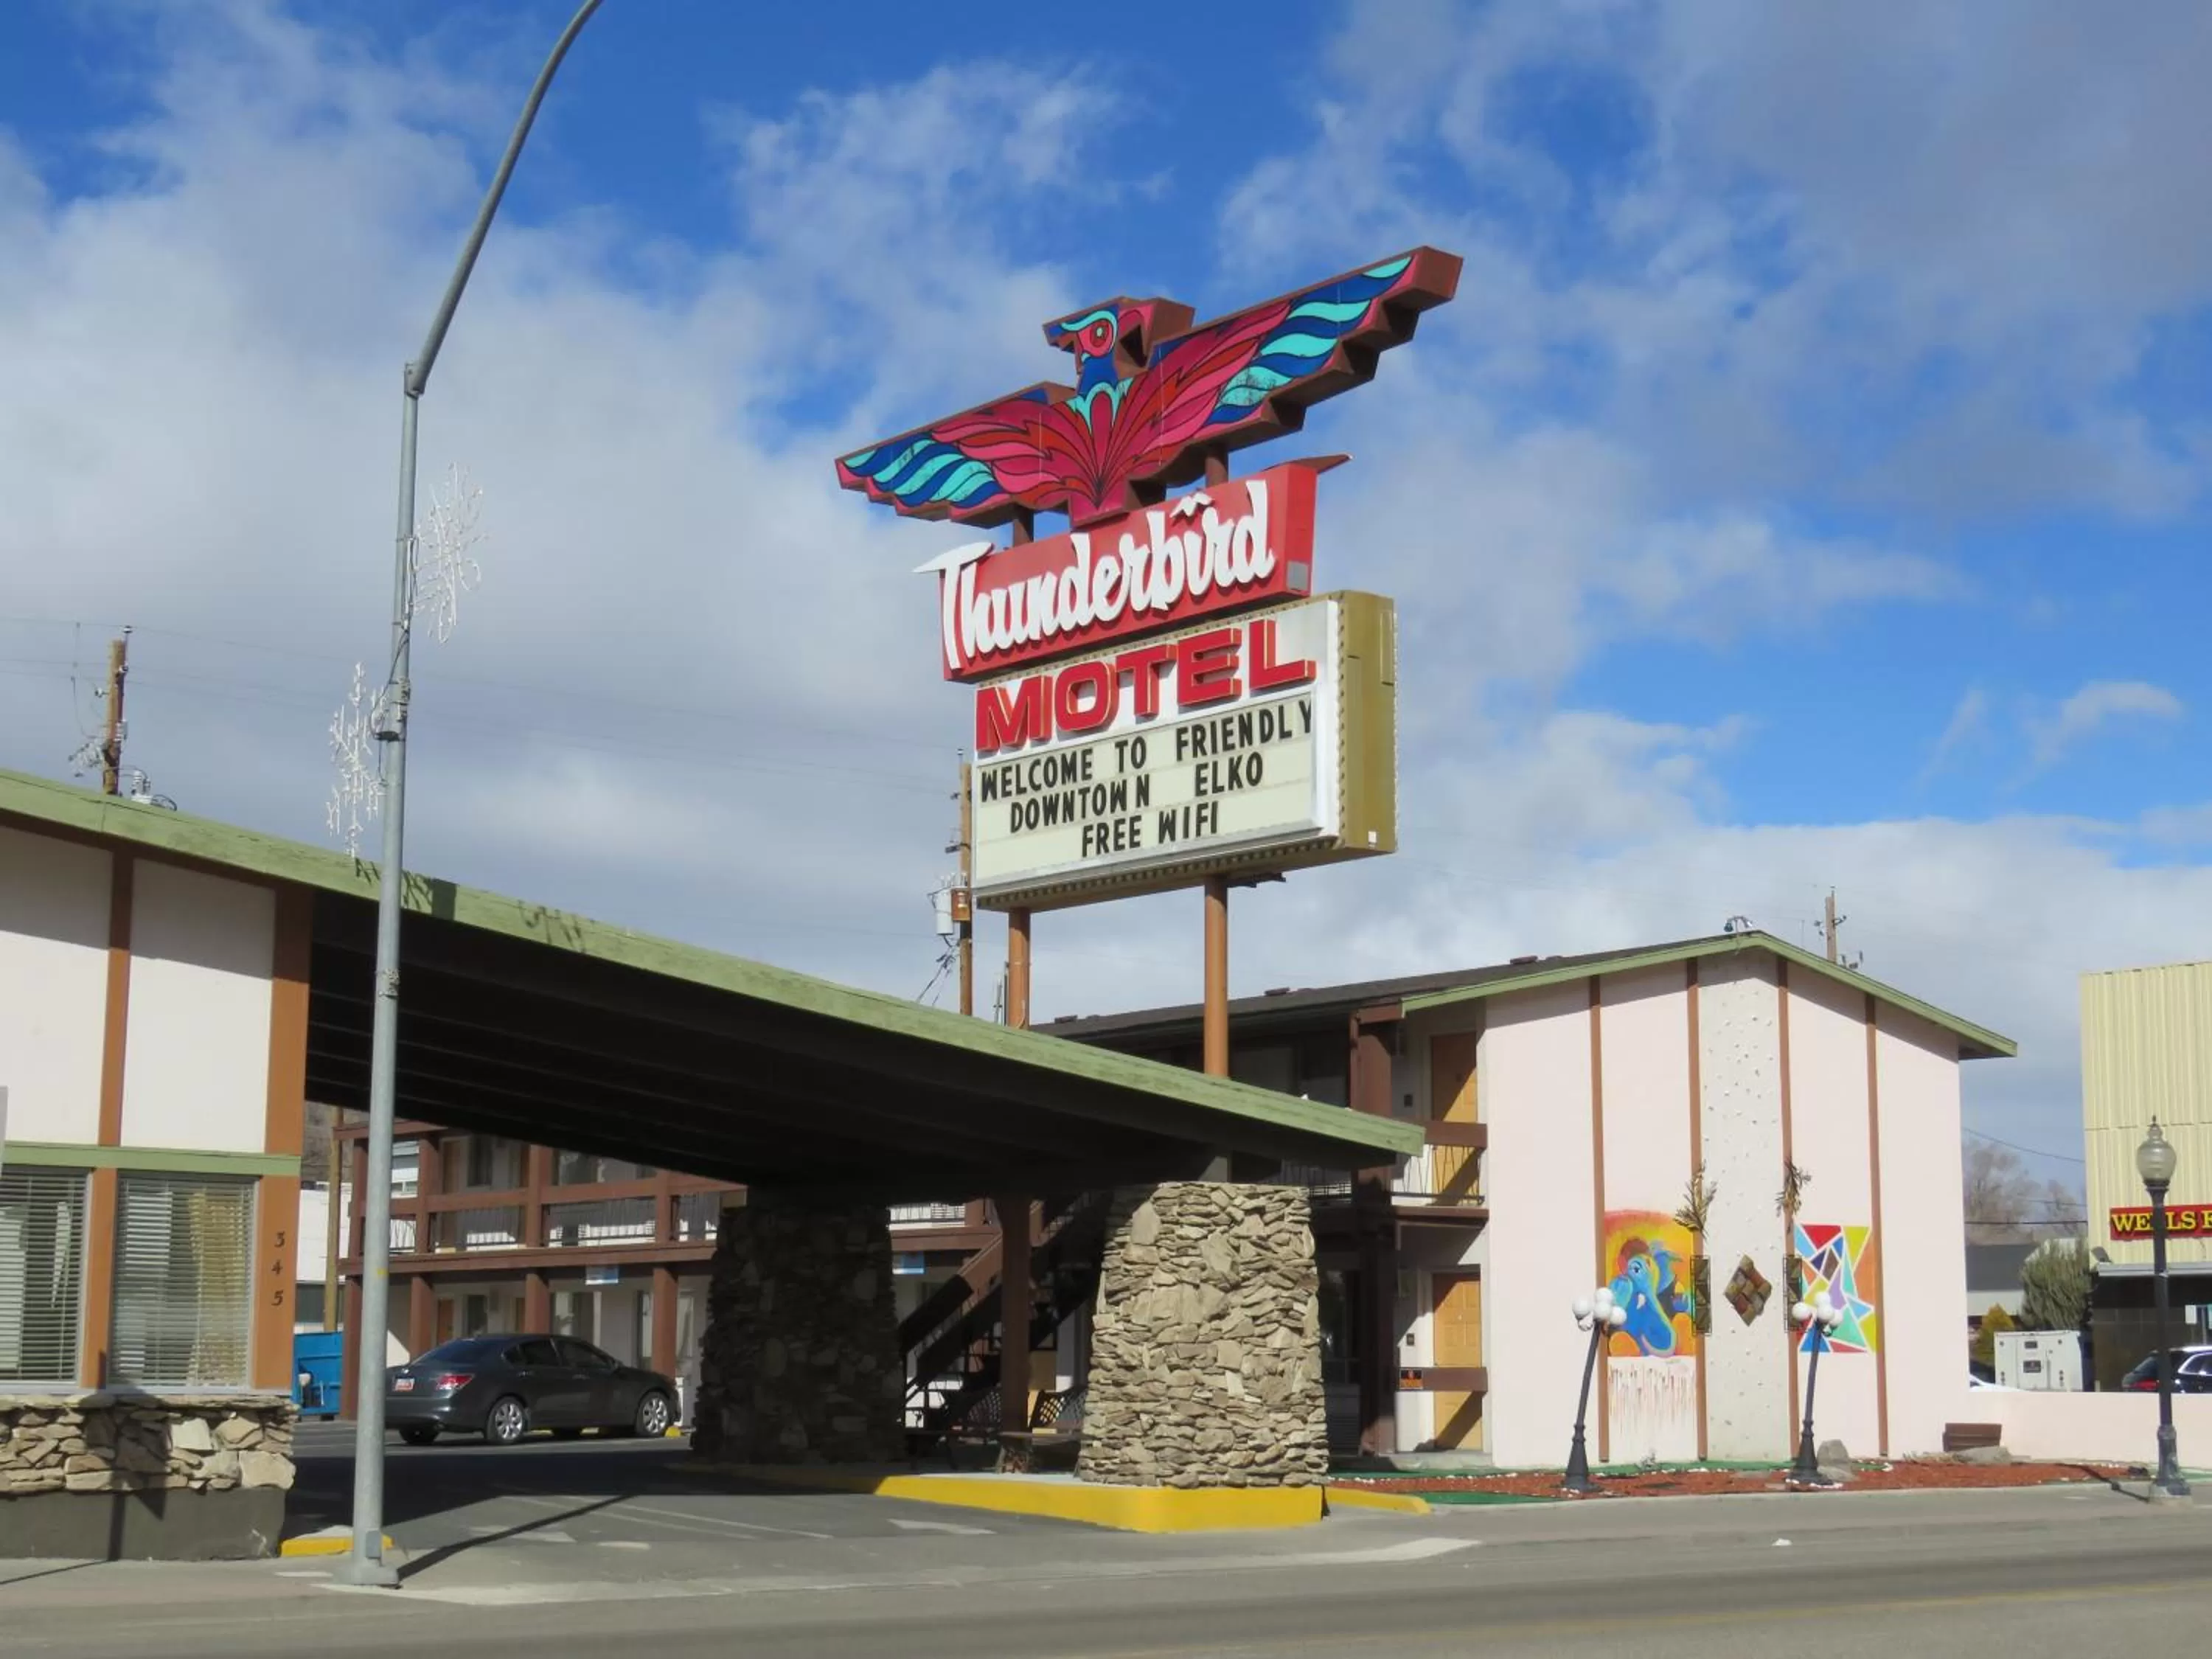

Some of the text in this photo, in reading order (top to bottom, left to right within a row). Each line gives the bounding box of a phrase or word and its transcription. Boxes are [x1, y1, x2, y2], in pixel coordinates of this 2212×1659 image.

[912, 479, 1276, 669] Thunderbird
[975, 619, 1316, 753] MOTEL
[981, 700, 1312, 802] WELCOME TO FRIENDLY
[1010, 751, 1263, 833] DOWNTOWN ELKO
[1082, 800, 1219, 858] FREE WIFI
[2112, 1211, 2197, 1231] WELS
